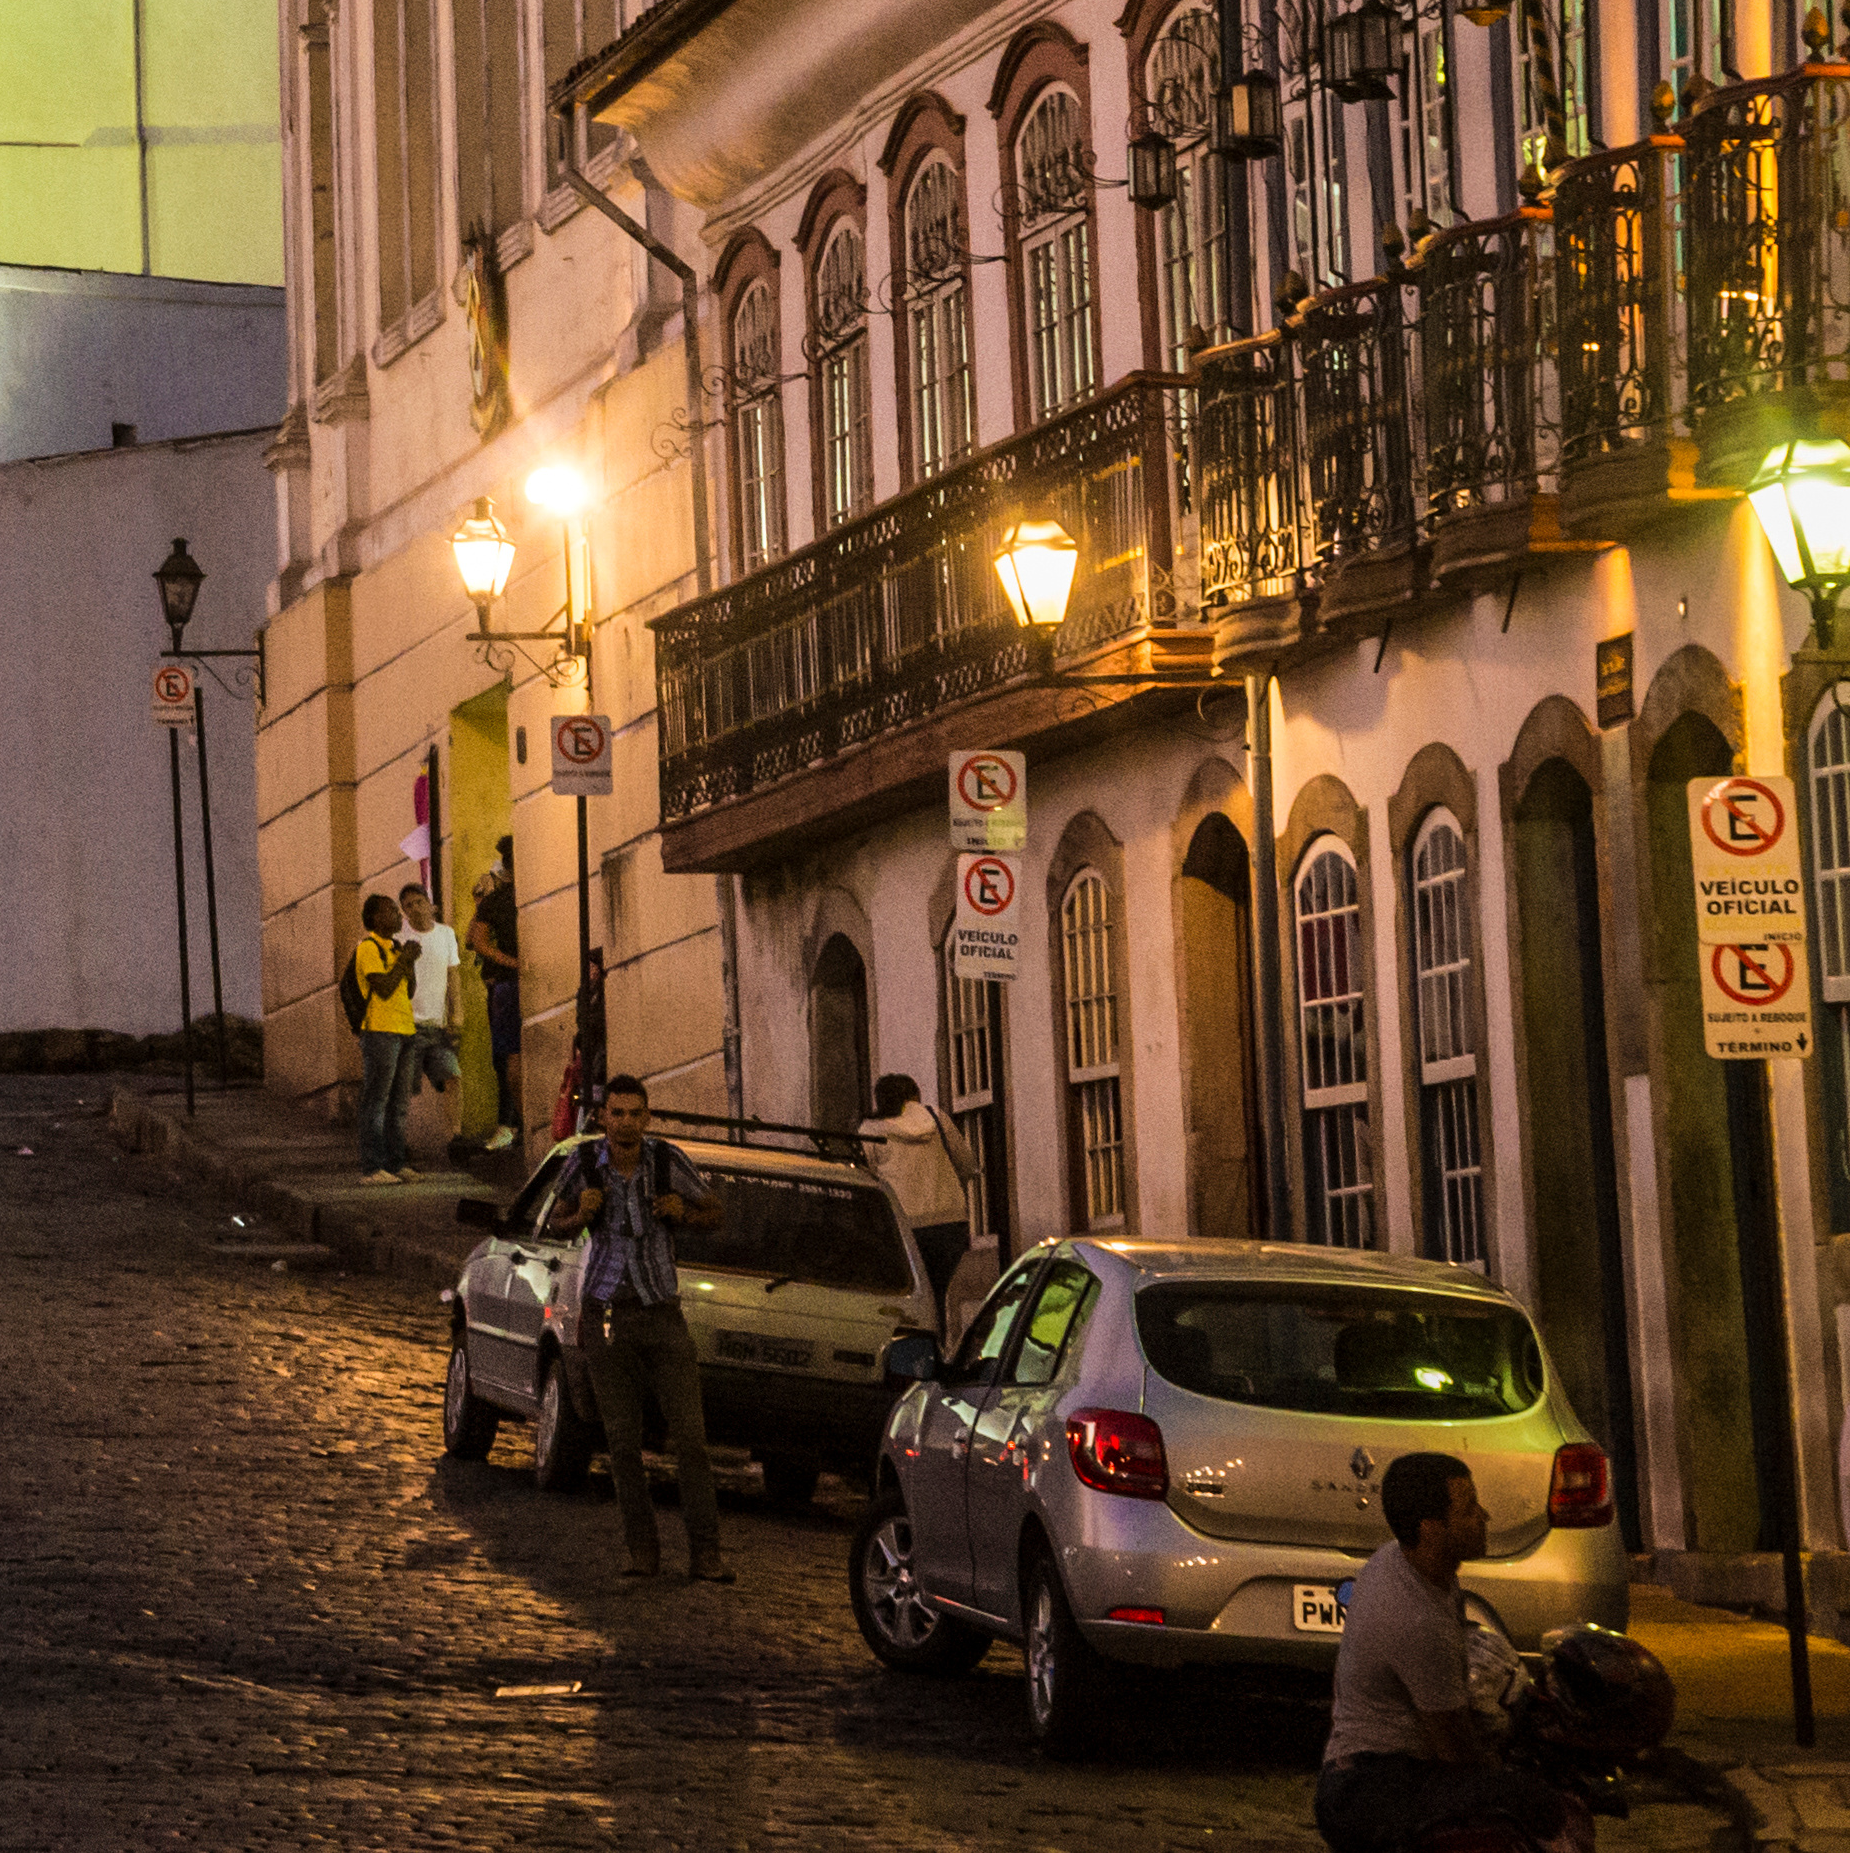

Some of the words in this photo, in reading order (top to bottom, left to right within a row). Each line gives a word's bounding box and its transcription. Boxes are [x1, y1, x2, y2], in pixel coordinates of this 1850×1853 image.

[1700, 876, 1799, 896] VEÍCULO
[1706, 899, 1797, 915] OFICIAL
[960, 944, 1015, 960] OFICIAL
